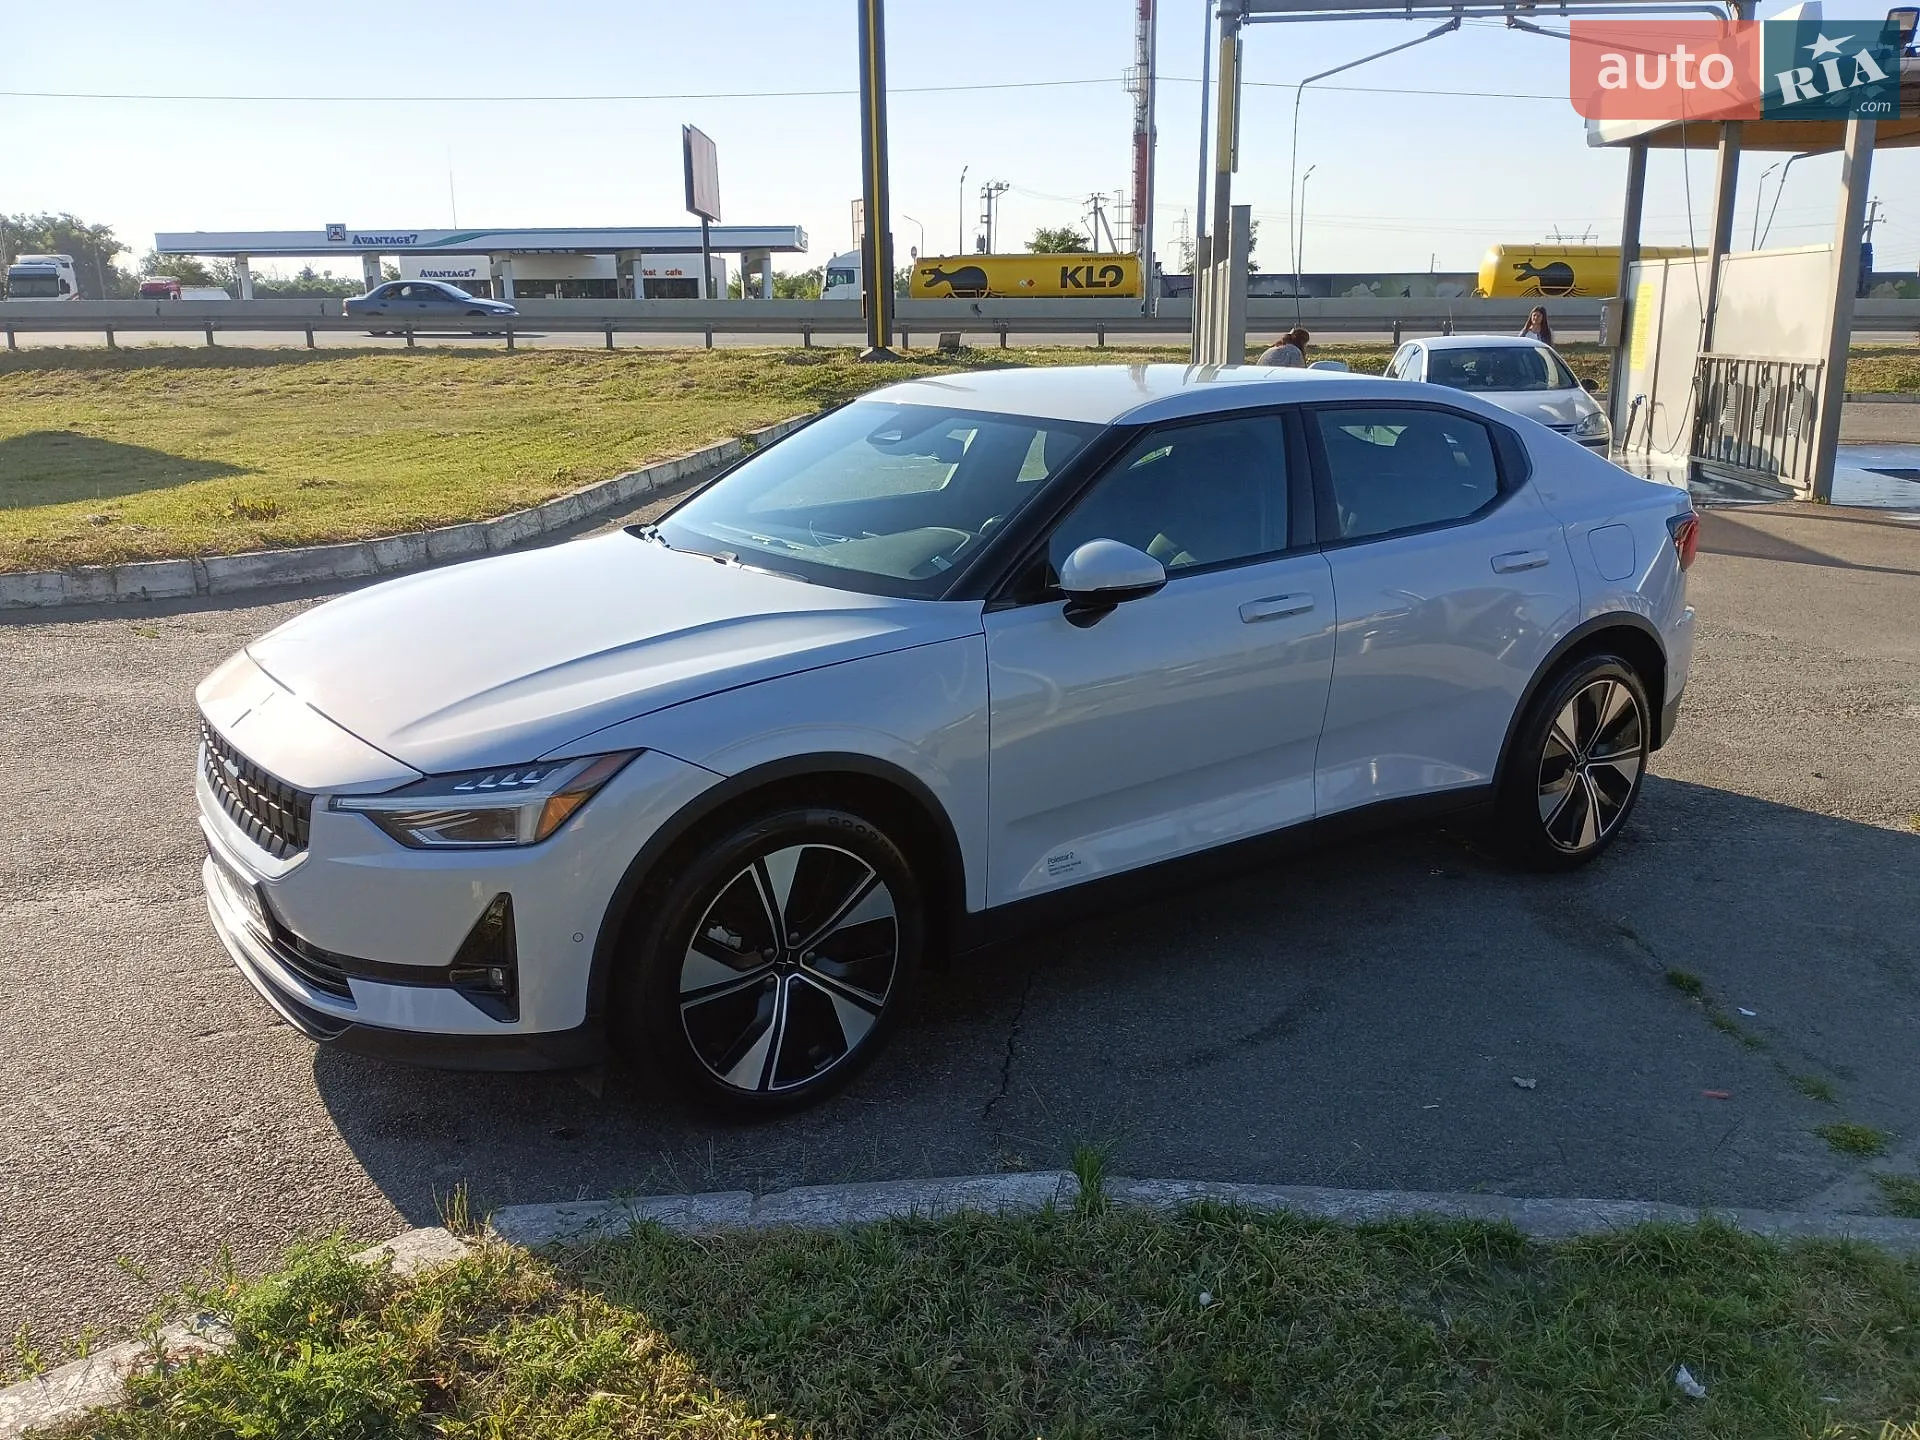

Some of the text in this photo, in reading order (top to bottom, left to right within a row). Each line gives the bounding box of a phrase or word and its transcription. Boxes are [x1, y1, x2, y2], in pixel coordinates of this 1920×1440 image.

[352, 234, 418, 245] AVANTAGE7
[420, 268, 476, 278] AVANTAGE7
[1060, 264, 1124, 289] KLO
